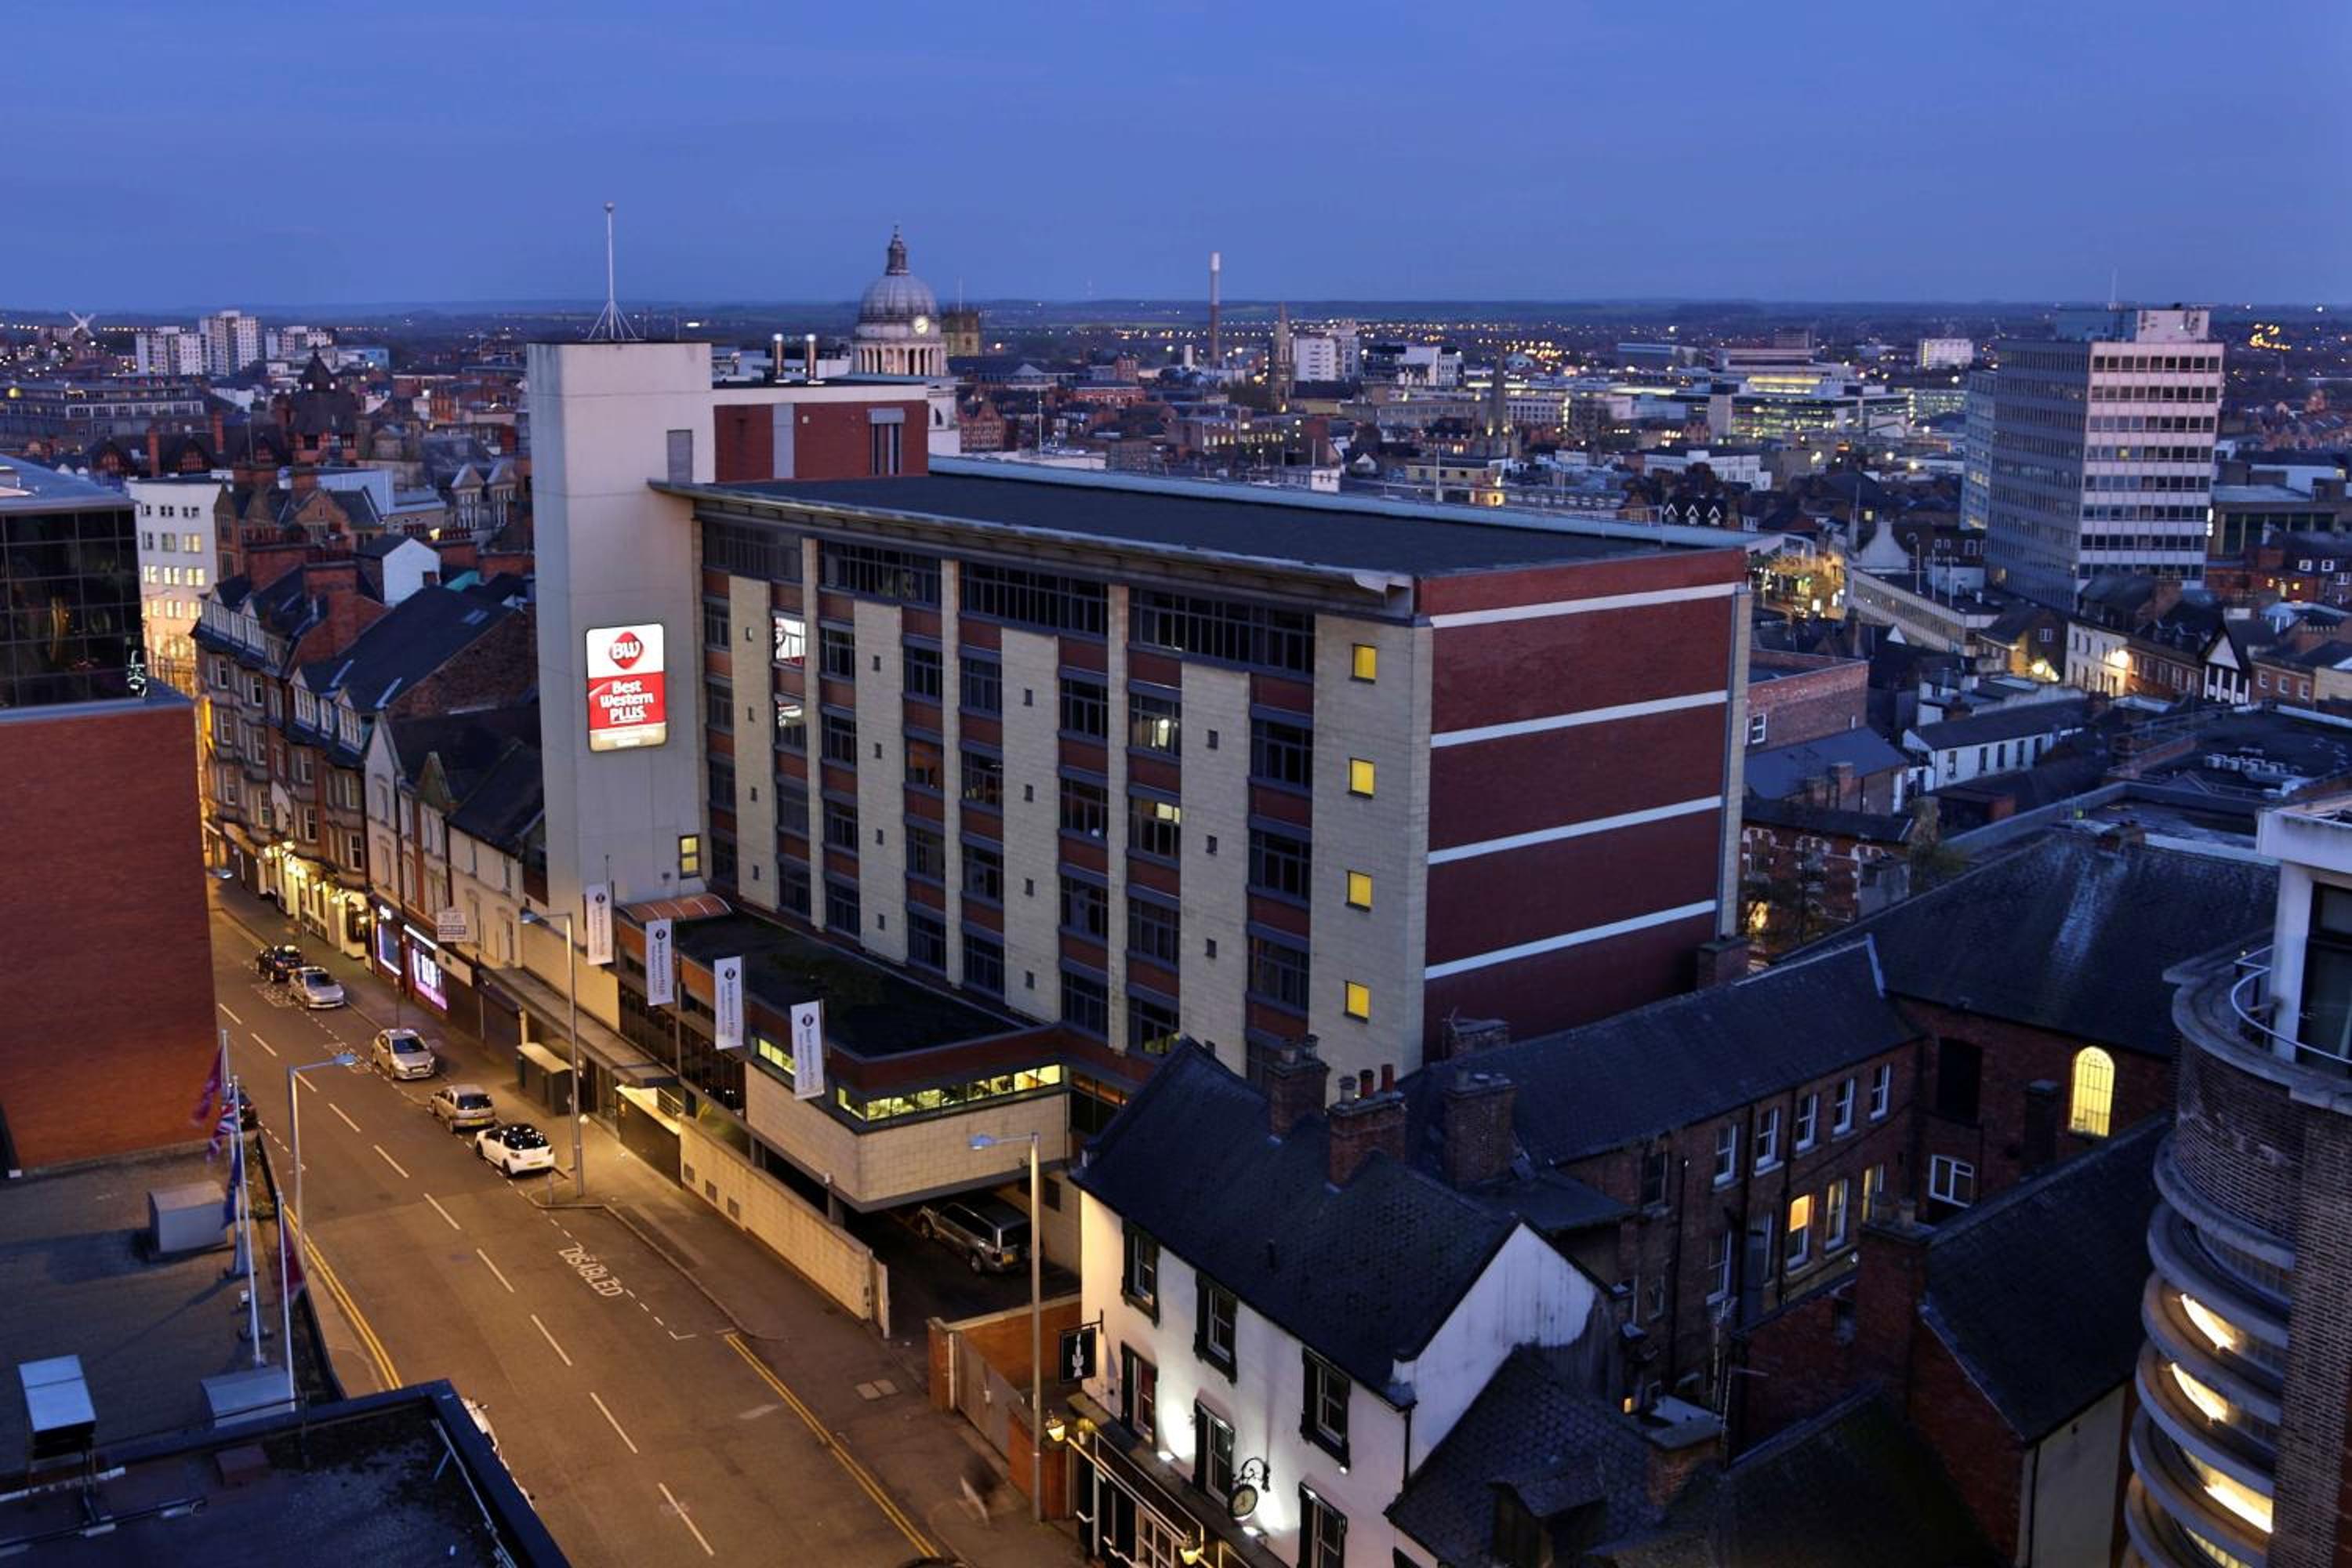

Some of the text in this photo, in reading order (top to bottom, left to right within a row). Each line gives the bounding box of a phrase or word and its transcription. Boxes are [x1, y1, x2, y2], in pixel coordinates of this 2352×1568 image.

[613, 641, 641, 659] BW
[612, 681, 642, 694] Best
[600, 693, 655, 708] Western
[609, 706, 644, 721] PLUS
